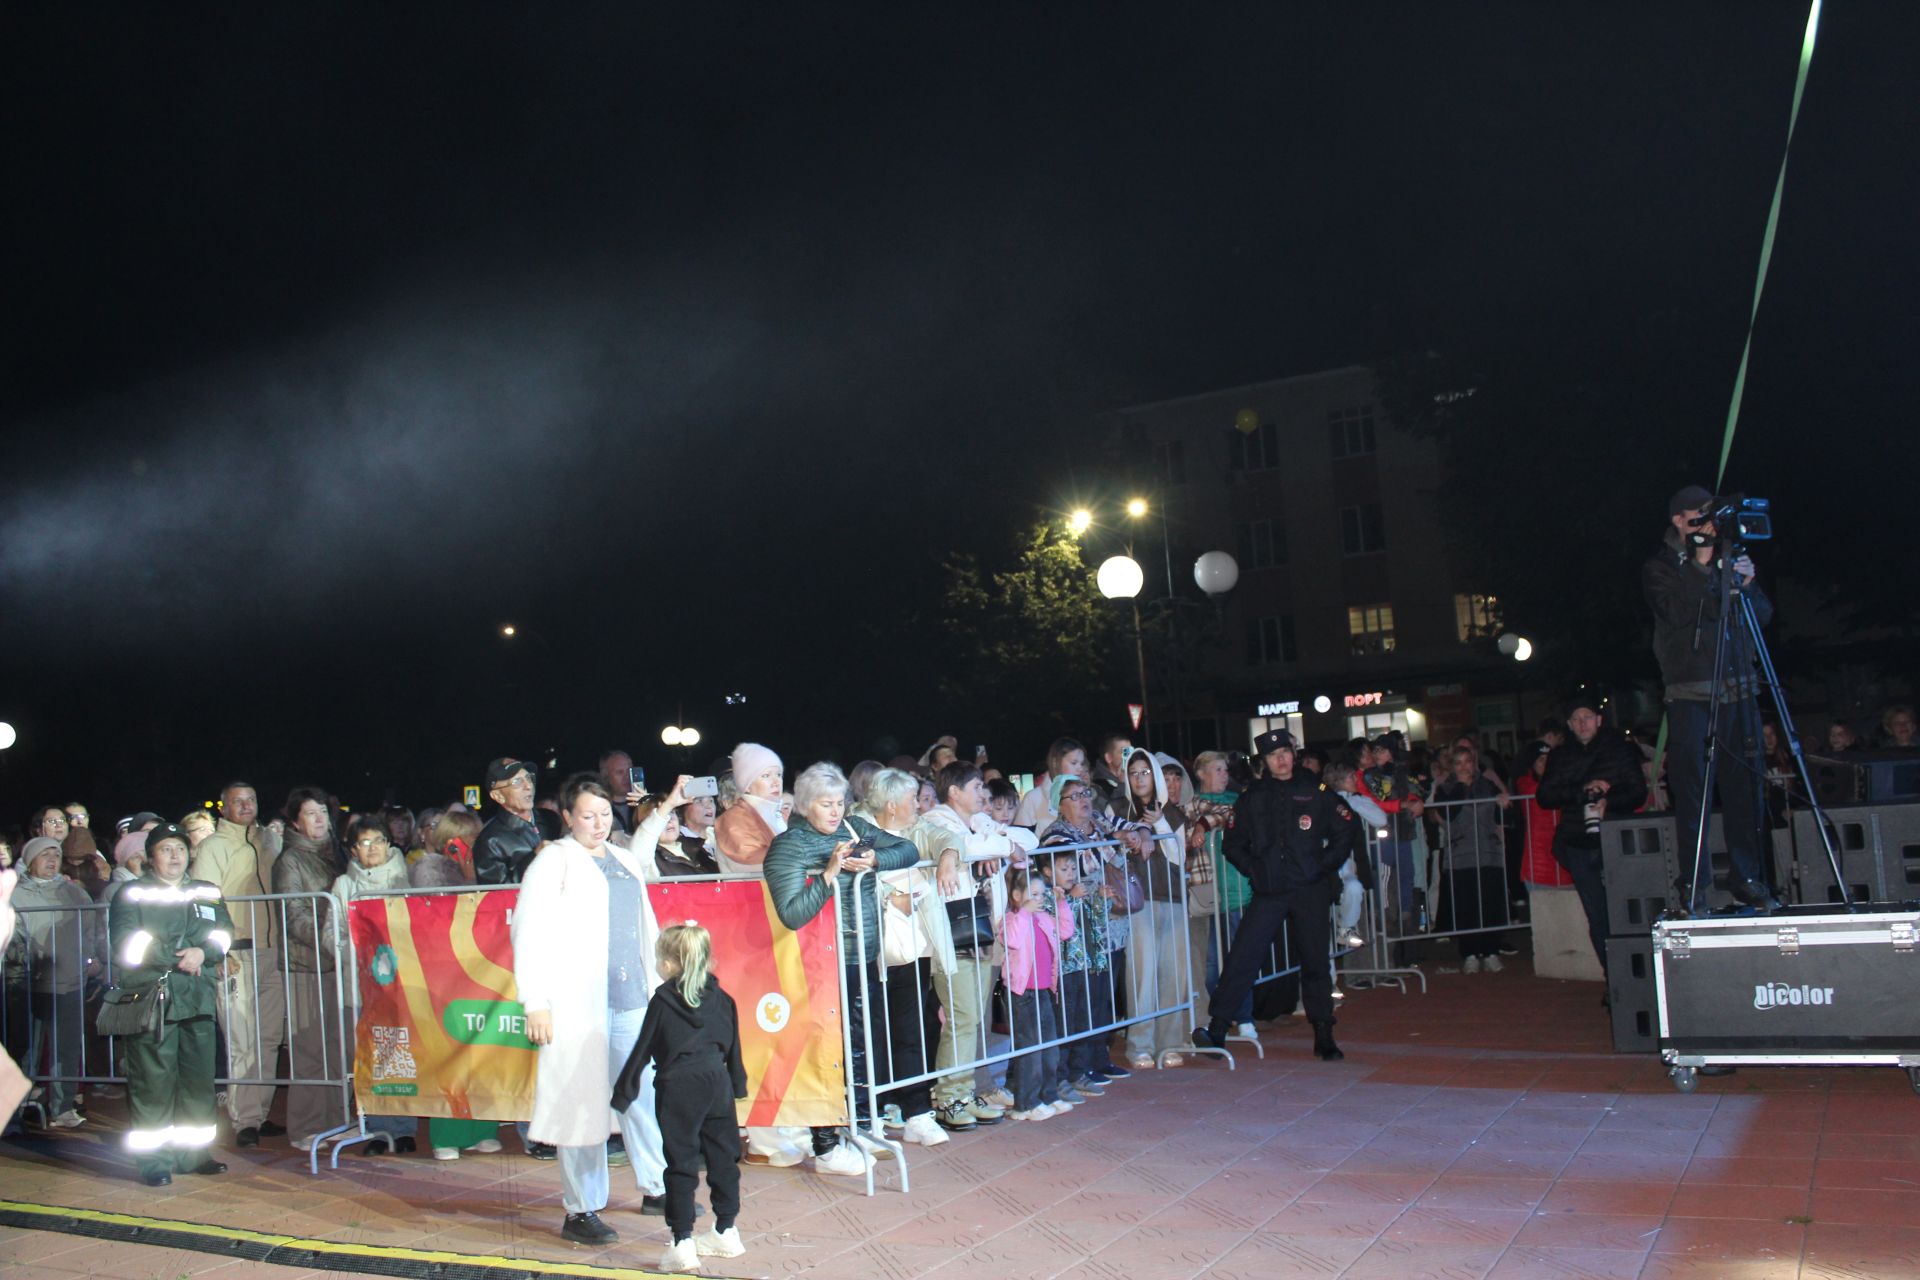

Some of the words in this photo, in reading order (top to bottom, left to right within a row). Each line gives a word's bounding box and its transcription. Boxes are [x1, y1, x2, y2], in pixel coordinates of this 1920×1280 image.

[1344, 692, 1382, 707] ПОРТ
[1258, 701, 1299, 716] МАРКЕТ
[1754, 982, 1834, 1010] Dicolor
[462, 1013, 486, 1032] ТО
